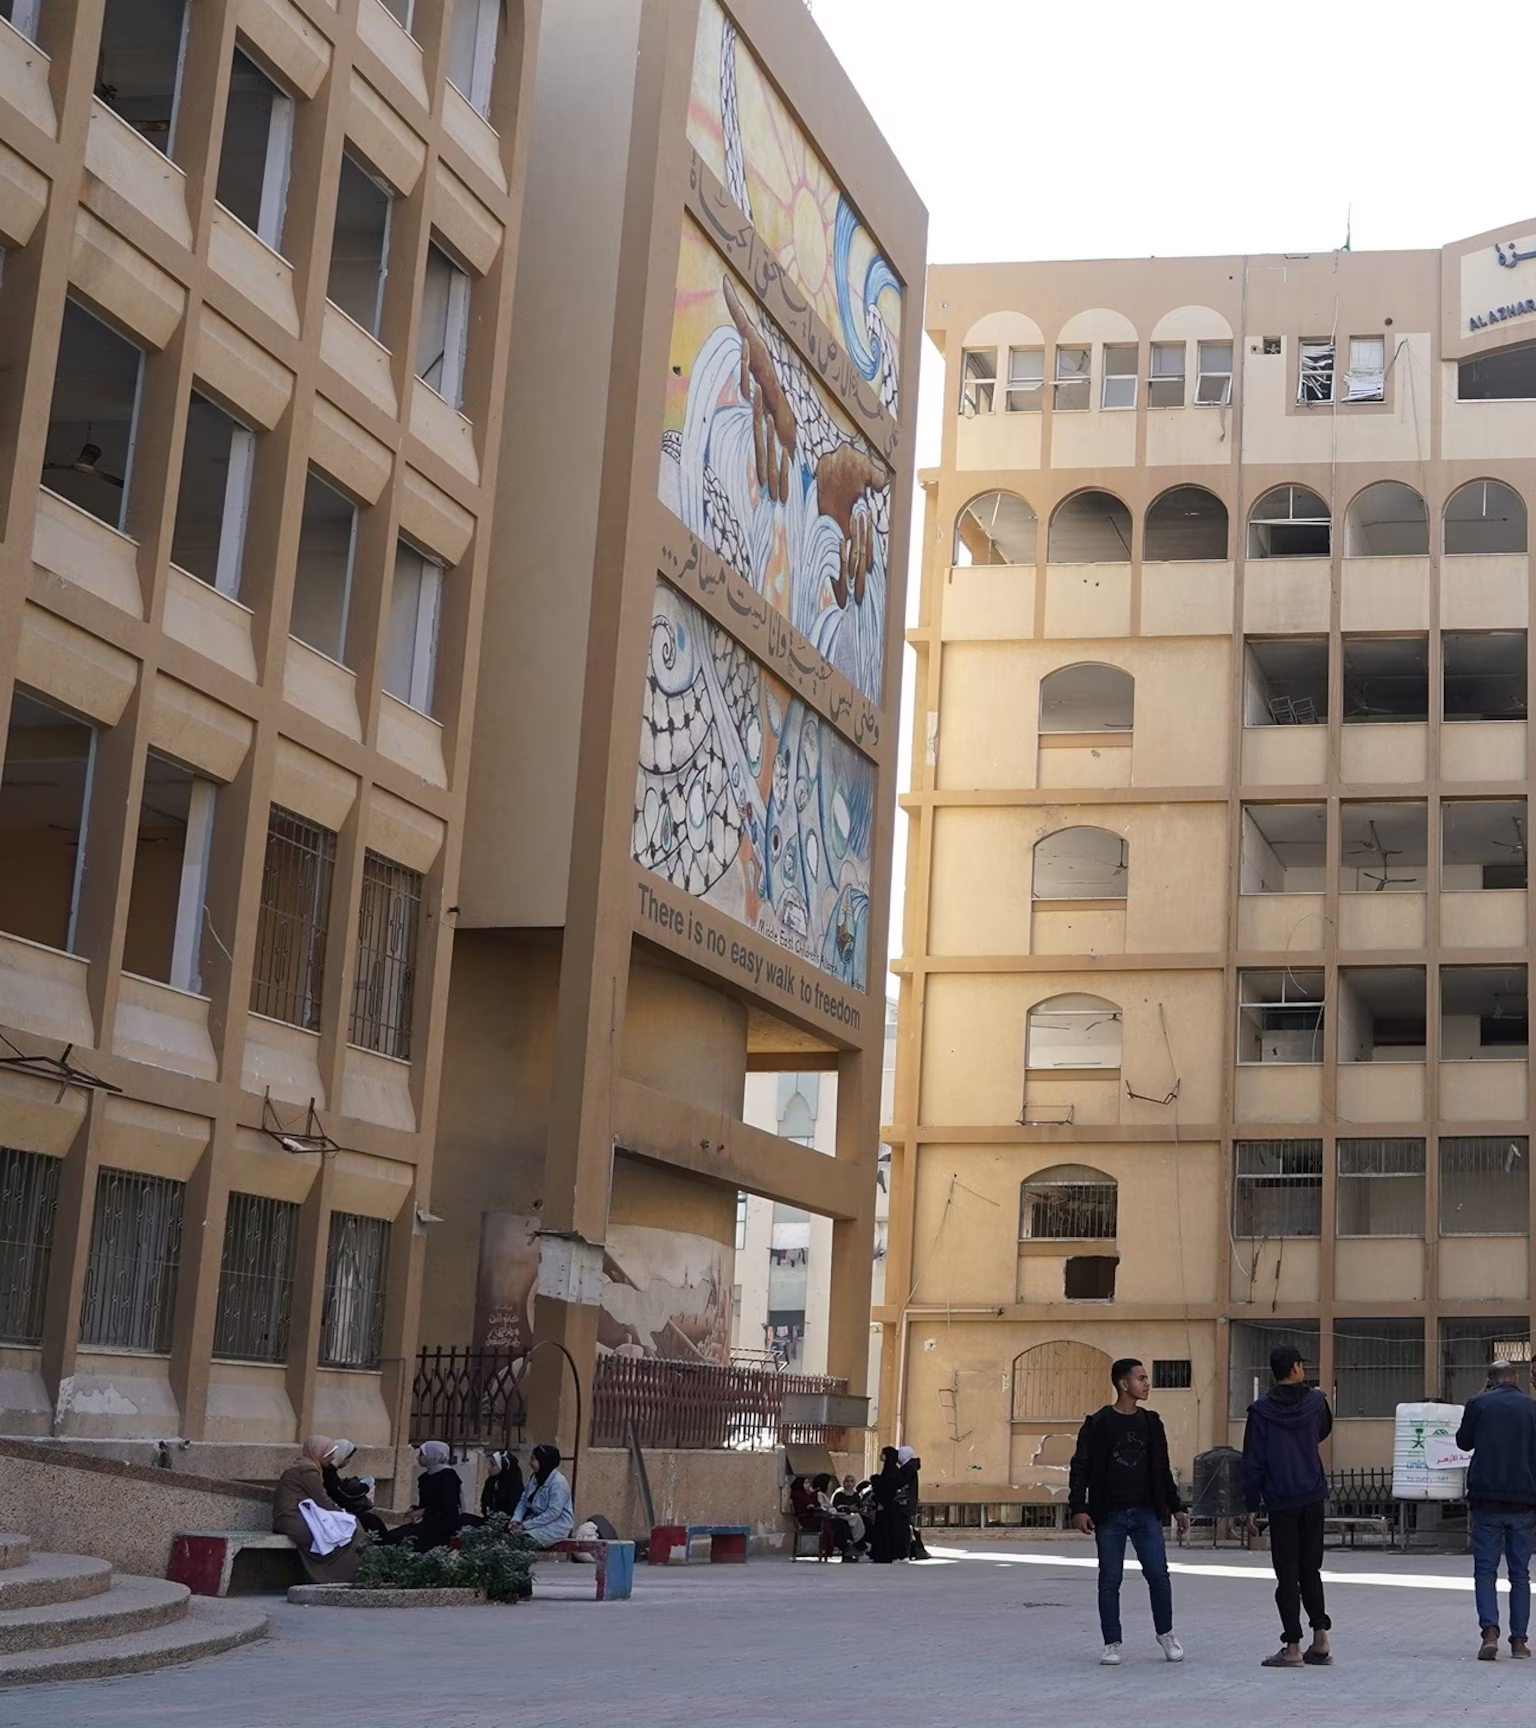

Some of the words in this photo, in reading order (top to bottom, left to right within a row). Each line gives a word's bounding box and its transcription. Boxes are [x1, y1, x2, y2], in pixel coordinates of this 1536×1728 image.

[1469, 315, 1488, 331] AL
[1489, 299, 1536, 325] AZHAR
[638, 882, 684, 936] There
[688, 911, 704, 945] is
[706, 926, 727, 958] no
[730, 941, 763, 984] easy
[766, 960, 796, 996] walk
[799, 973, 813, 1003] to
[815, 981, 861, 1031] freedom
[1406, 1459, 1427, 1469] unic
